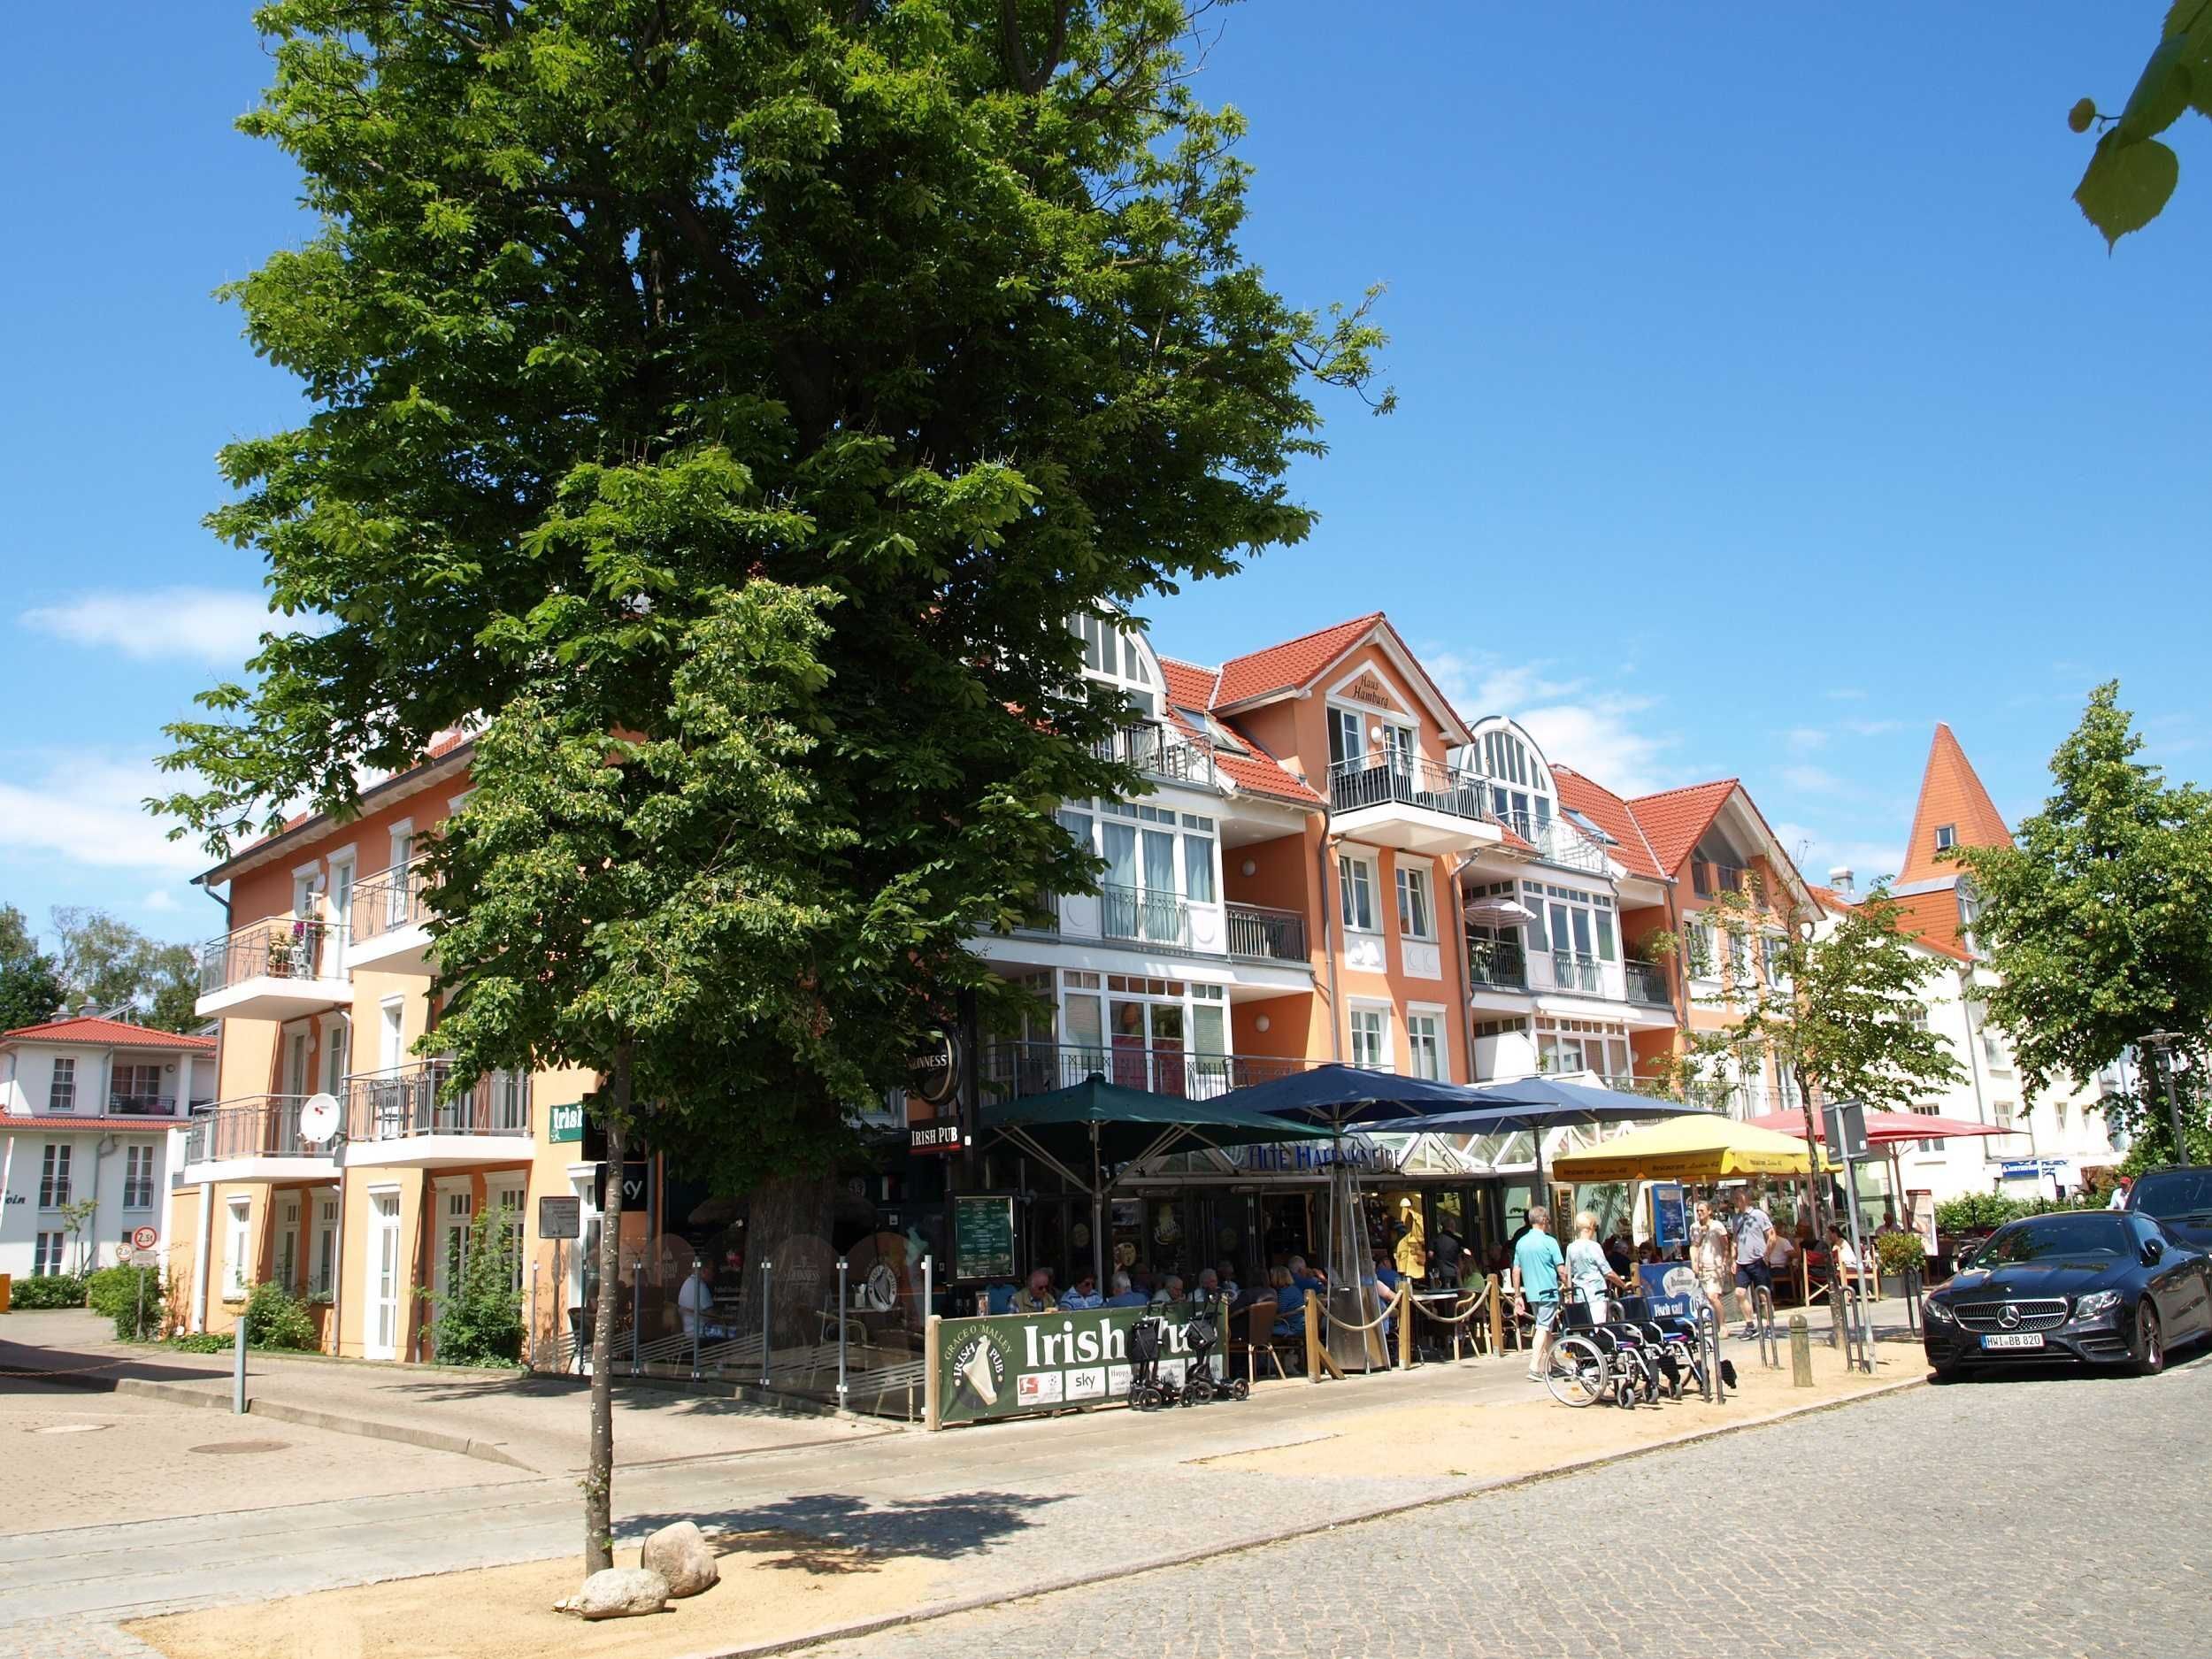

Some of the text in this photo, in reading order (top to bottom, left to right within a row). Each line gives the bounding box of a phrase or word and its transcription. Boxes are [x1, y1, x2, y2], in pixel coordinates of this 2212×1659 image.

[1361, 674, 1379, 690] Haus
[1353, 685, 1388, 709] Hamburg
[911, 1125, 958, 1147] IRISH PUB
[1024, 1318, 1127, 1367] Irish
[1986, 1334, 2040, 1346] HWI BB 820
[954, 1342, 1004, 1378] IRISH PUB
[1075, 1372, 1095, 1389] sky
